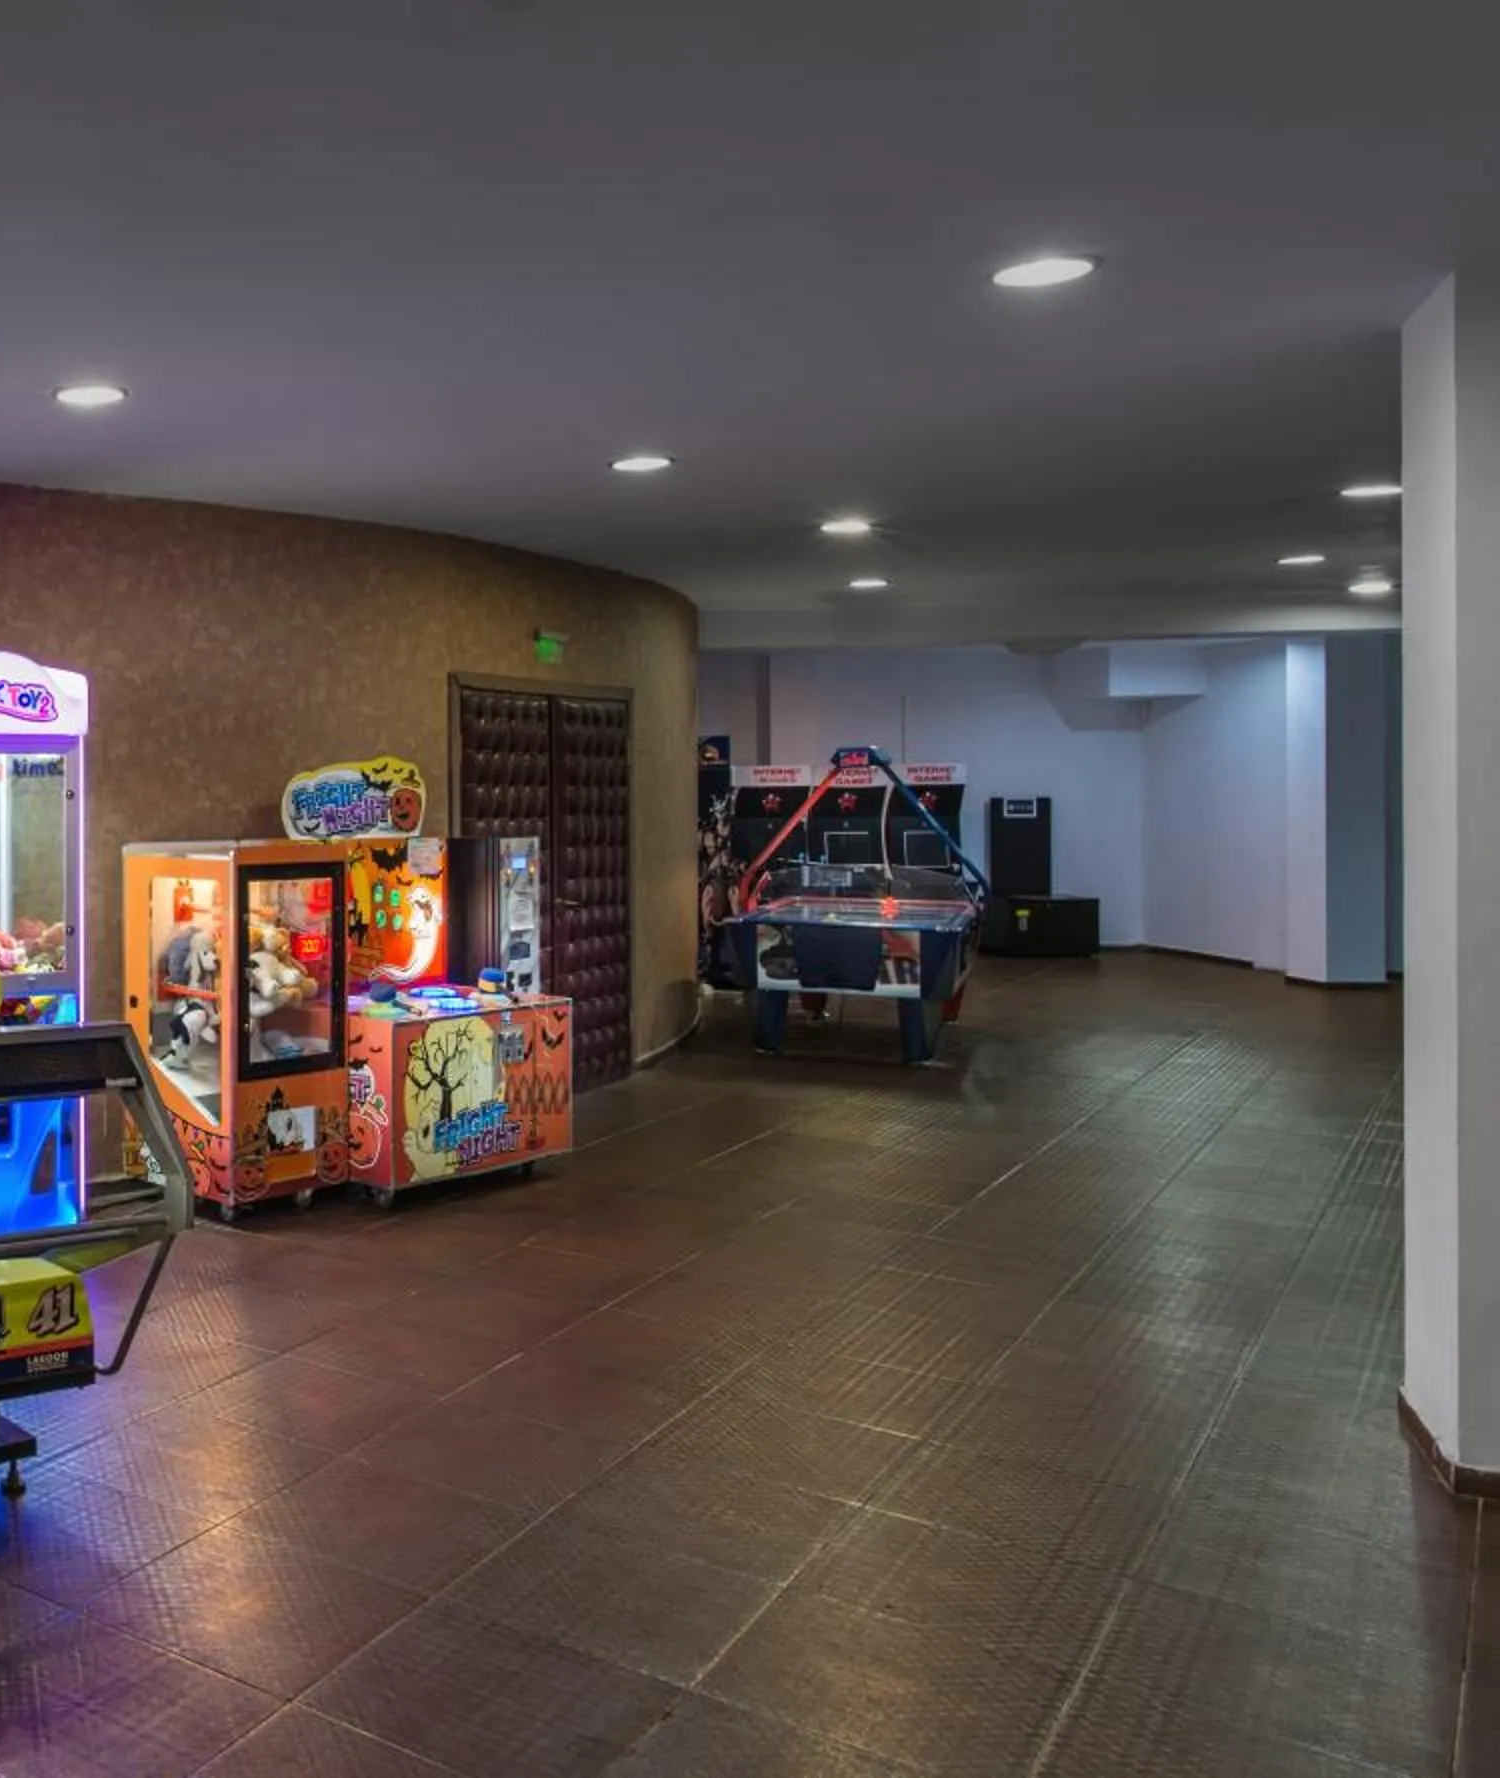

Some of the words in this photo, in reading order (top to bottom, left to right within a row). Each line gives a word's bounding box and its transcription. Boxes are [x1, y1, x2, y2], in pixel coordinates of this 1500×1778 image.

[434, 1100, 509, 1154] FRIGHT
[457, 1121, 521, 1167] NIGHT
[27, 1281, 80, 1337] 41
